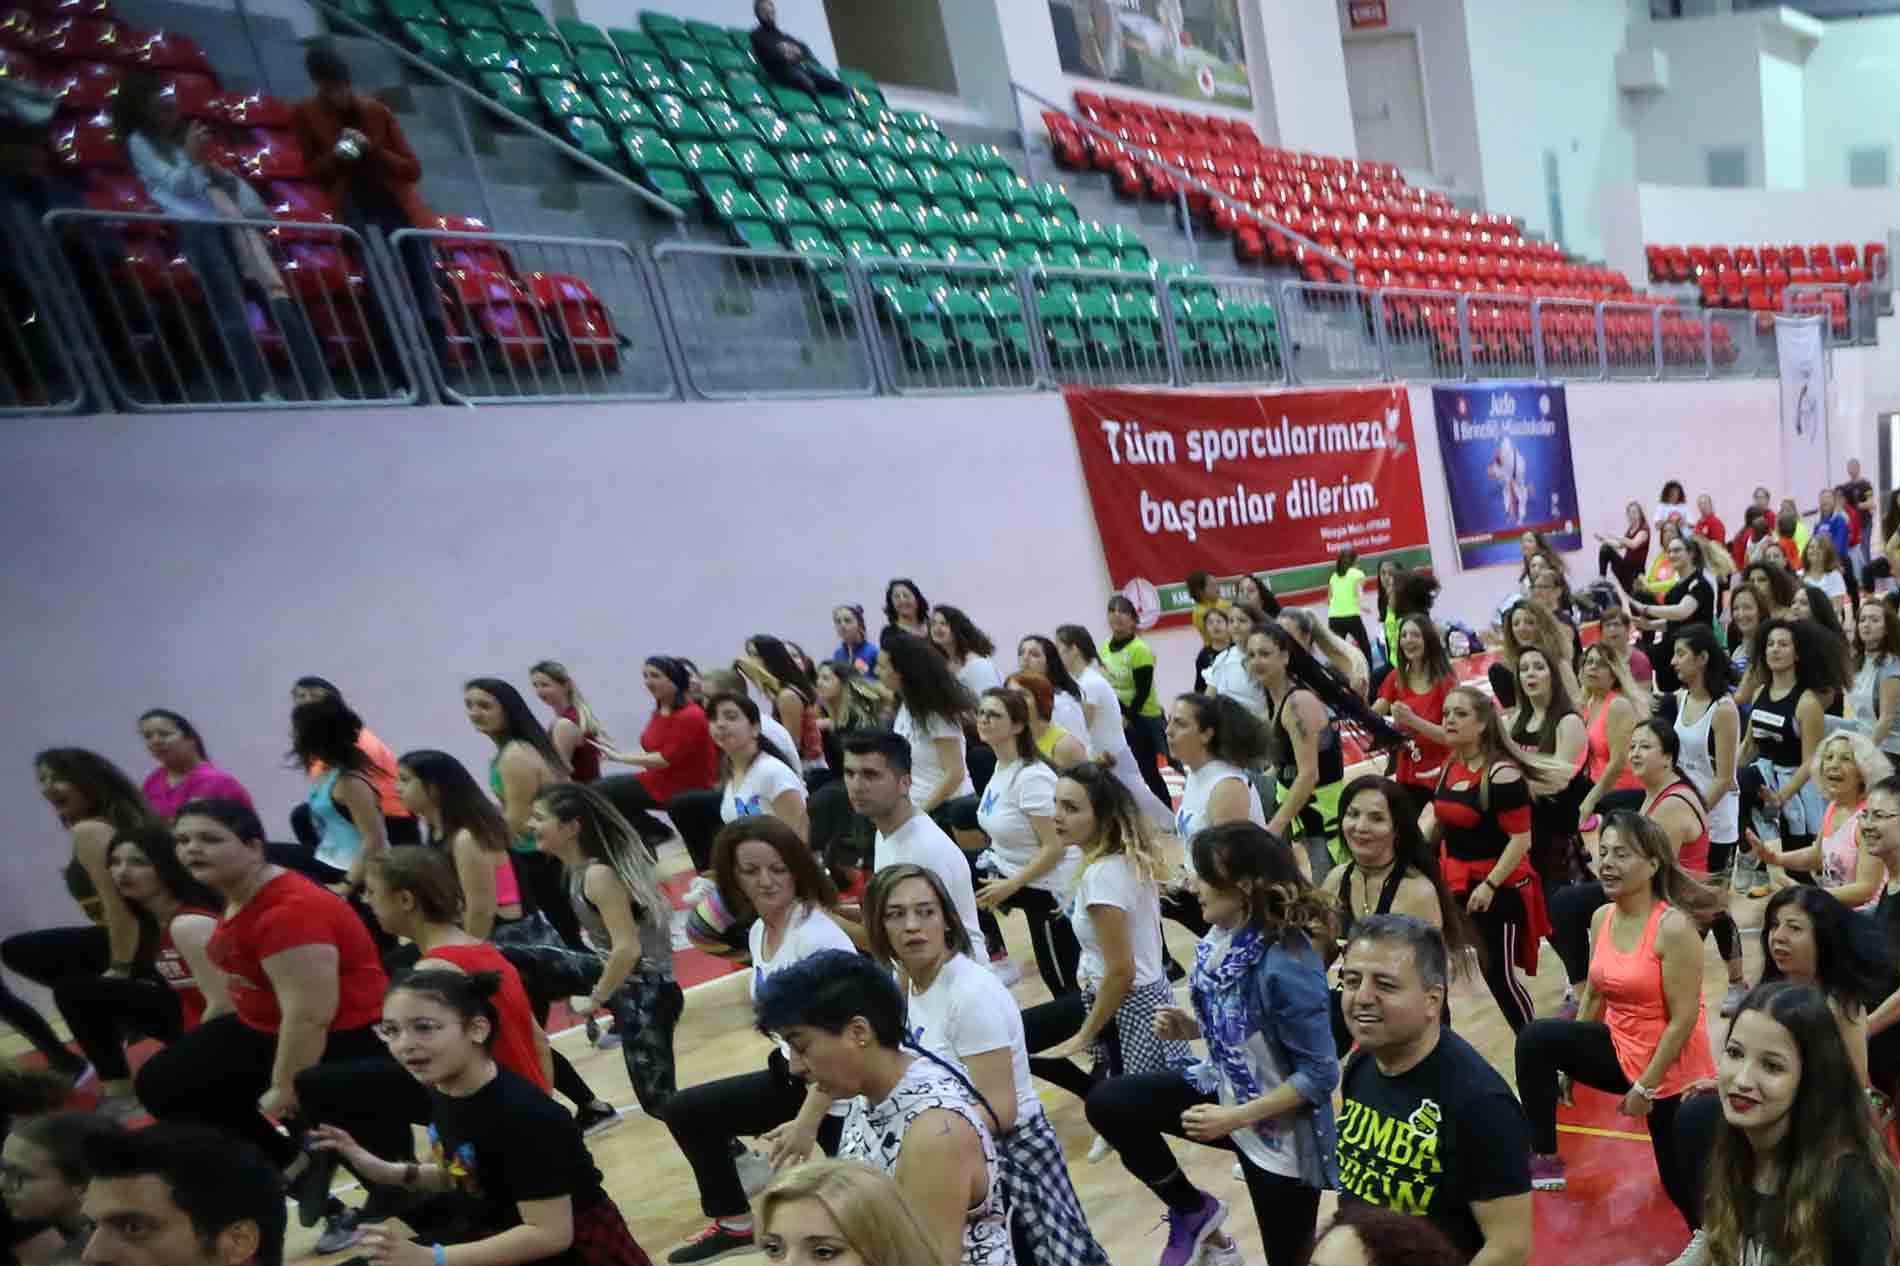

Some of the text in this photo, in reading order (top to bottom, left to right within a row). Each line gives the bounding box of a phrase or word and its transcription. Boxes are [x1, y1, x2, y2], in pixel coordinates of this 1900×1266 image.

[1101, 416, 1387, 472] Tüm sporcularımıza
[1139, 483, 1278, 543] başarılar
